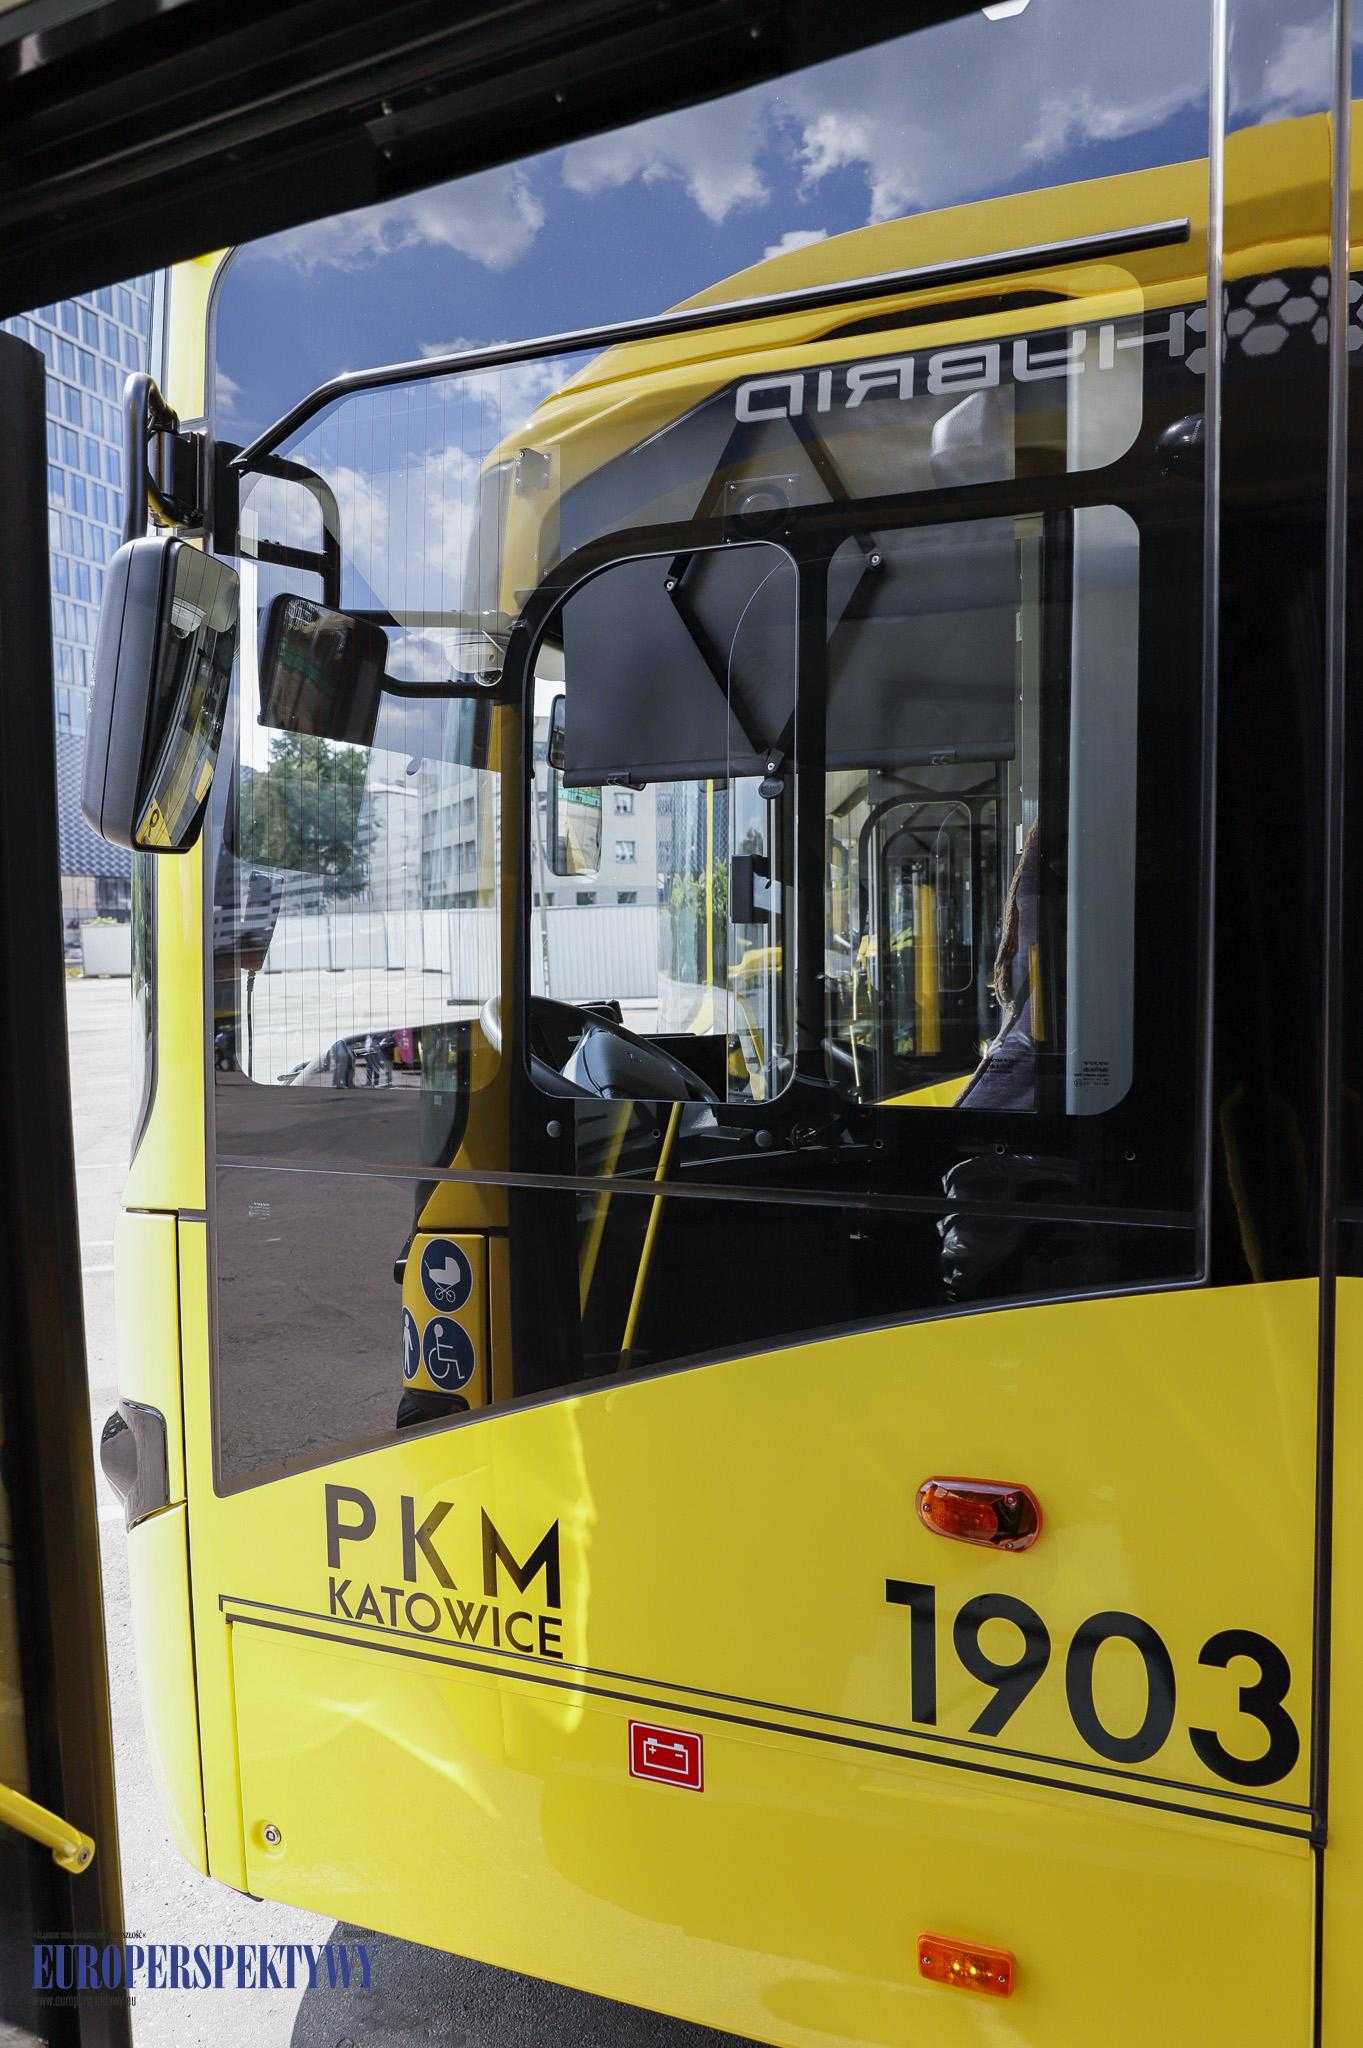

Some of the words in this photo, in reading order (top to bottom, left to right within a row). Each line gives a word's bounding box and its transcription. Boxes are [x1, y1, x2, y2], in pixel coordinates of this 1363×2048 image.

[324, 1483, 562, 1609] PKM
[328, 1576, 564, 1659] KATOWICE
[885, 1578, 1300, 1787] 1903
